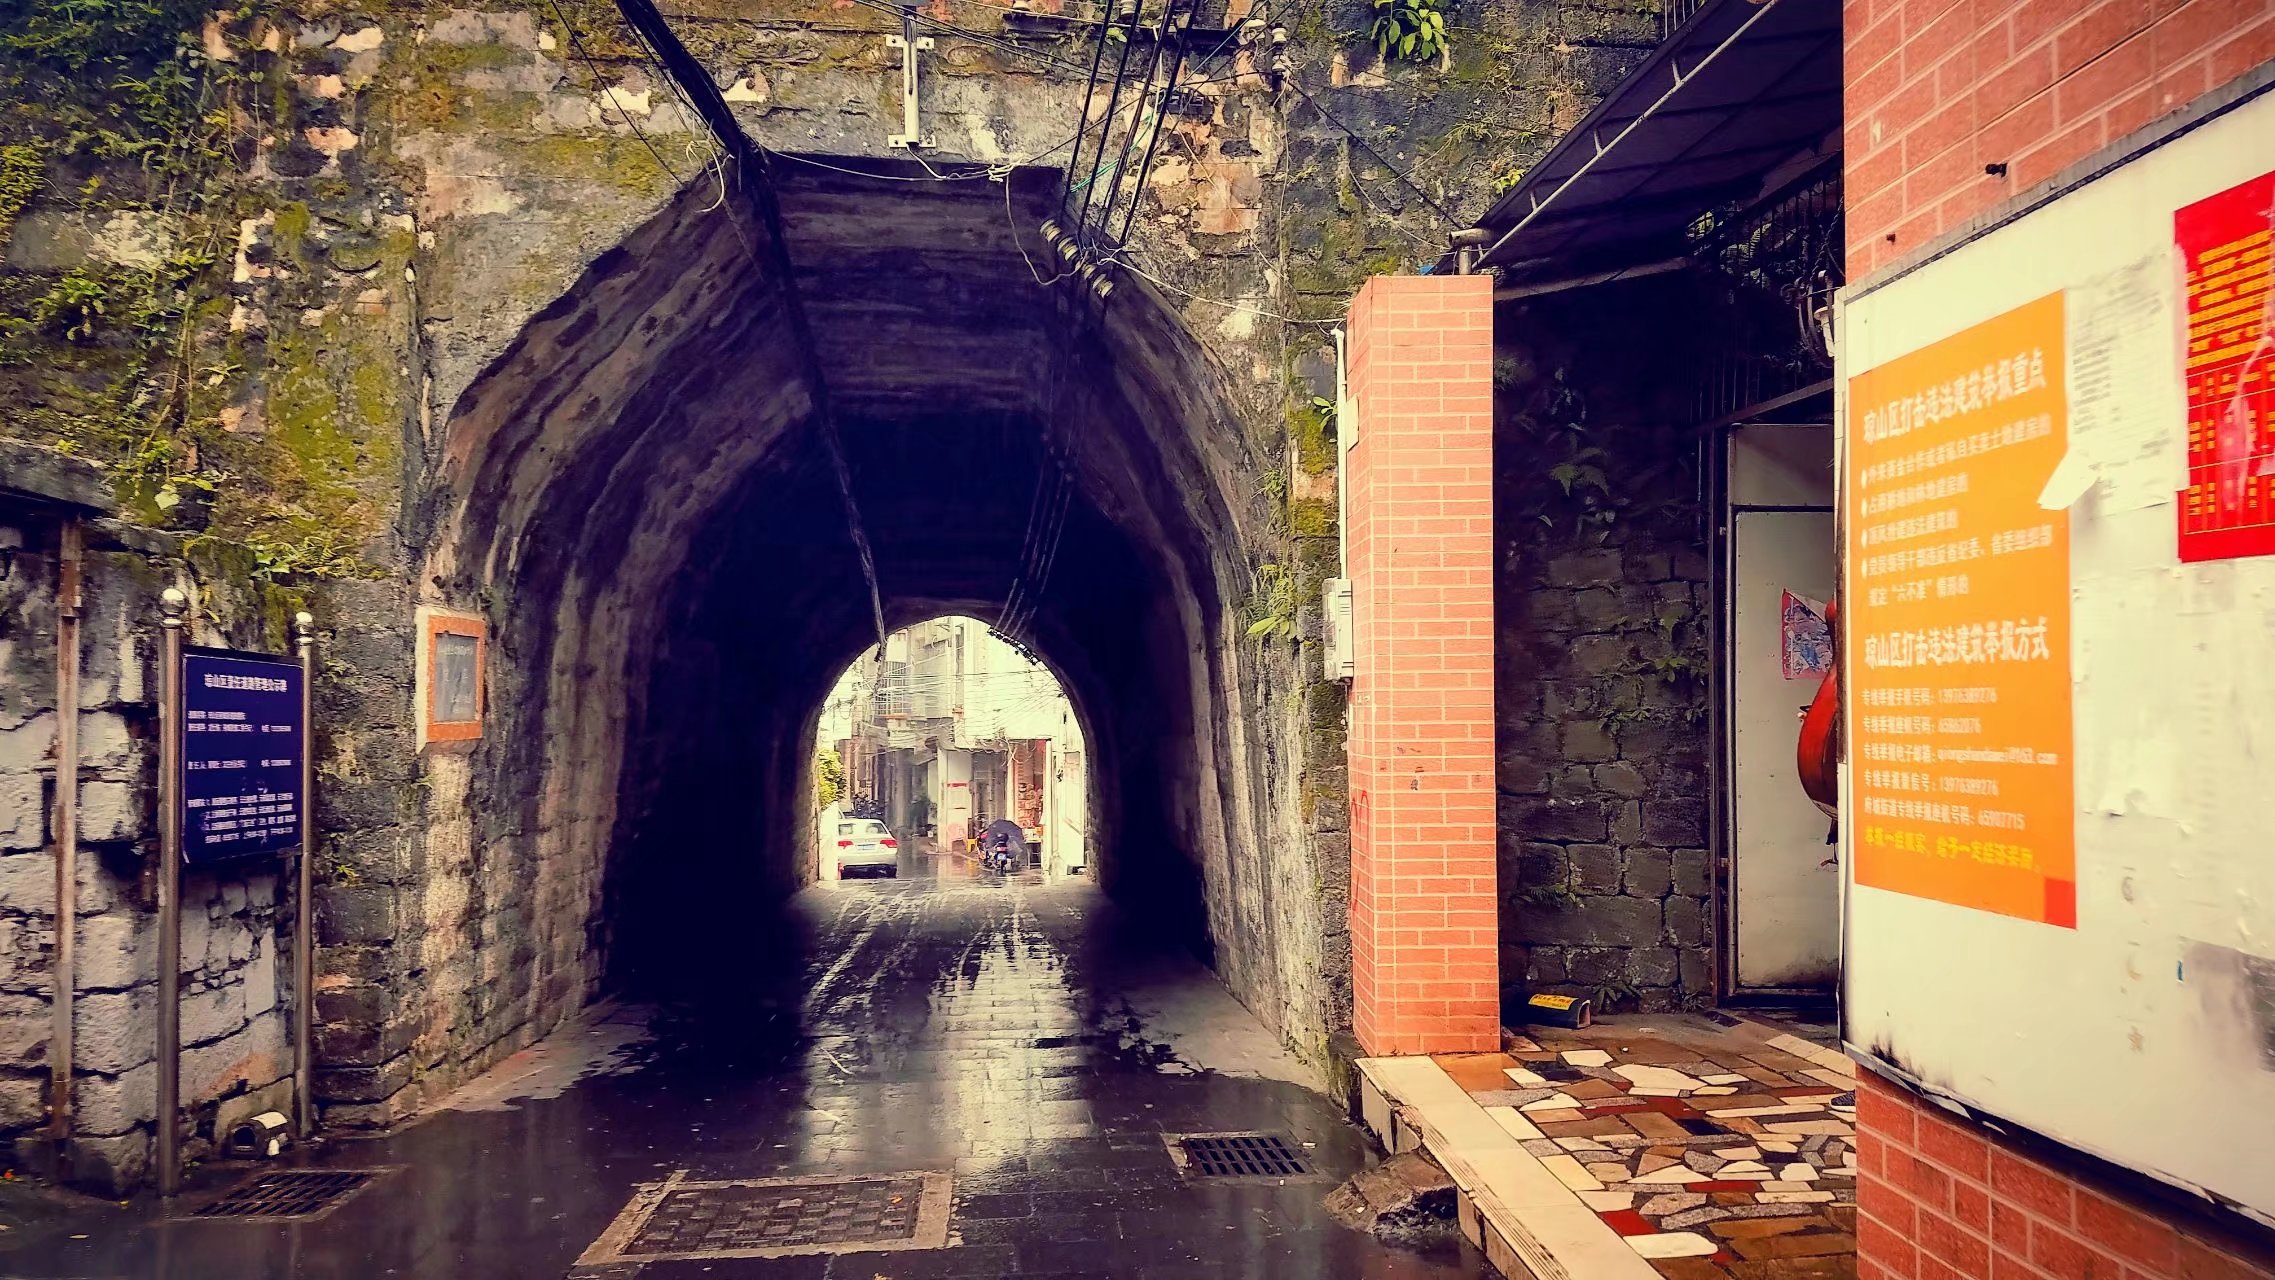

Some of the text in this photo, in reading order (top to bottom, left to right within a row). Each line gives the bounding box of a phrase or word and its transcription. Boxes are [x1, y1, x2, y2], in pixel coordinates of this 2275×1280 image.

[1863, 347, 2047, 445] 琼山区打击违法建筑举报重点
[1864, 616, 2049, 669] 琼山区打击违法建筑举报方式
